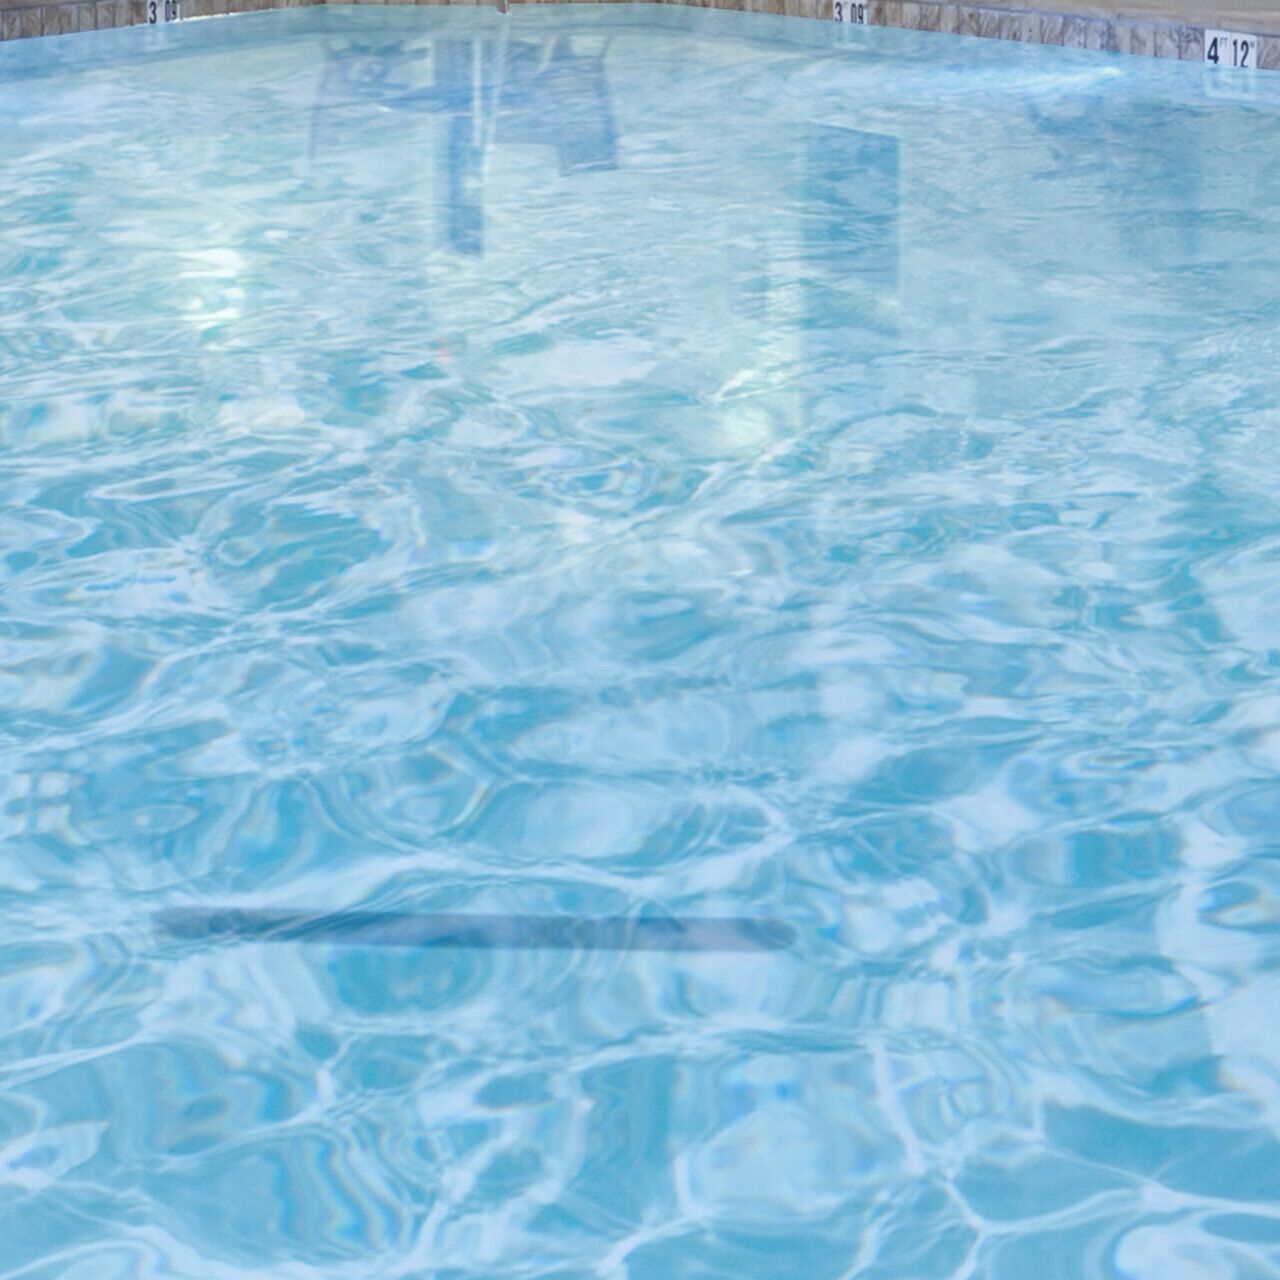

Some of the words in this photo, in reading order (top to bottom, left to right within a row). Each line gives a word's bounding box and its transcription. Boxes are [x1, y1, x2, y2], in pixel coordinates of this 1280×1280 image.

[149, 1, 157, 24] 3
[835, 1, 843, 22] 3
[1207, 37, 1219, 64] 4
[1233, 39, 1249, 68] 12
